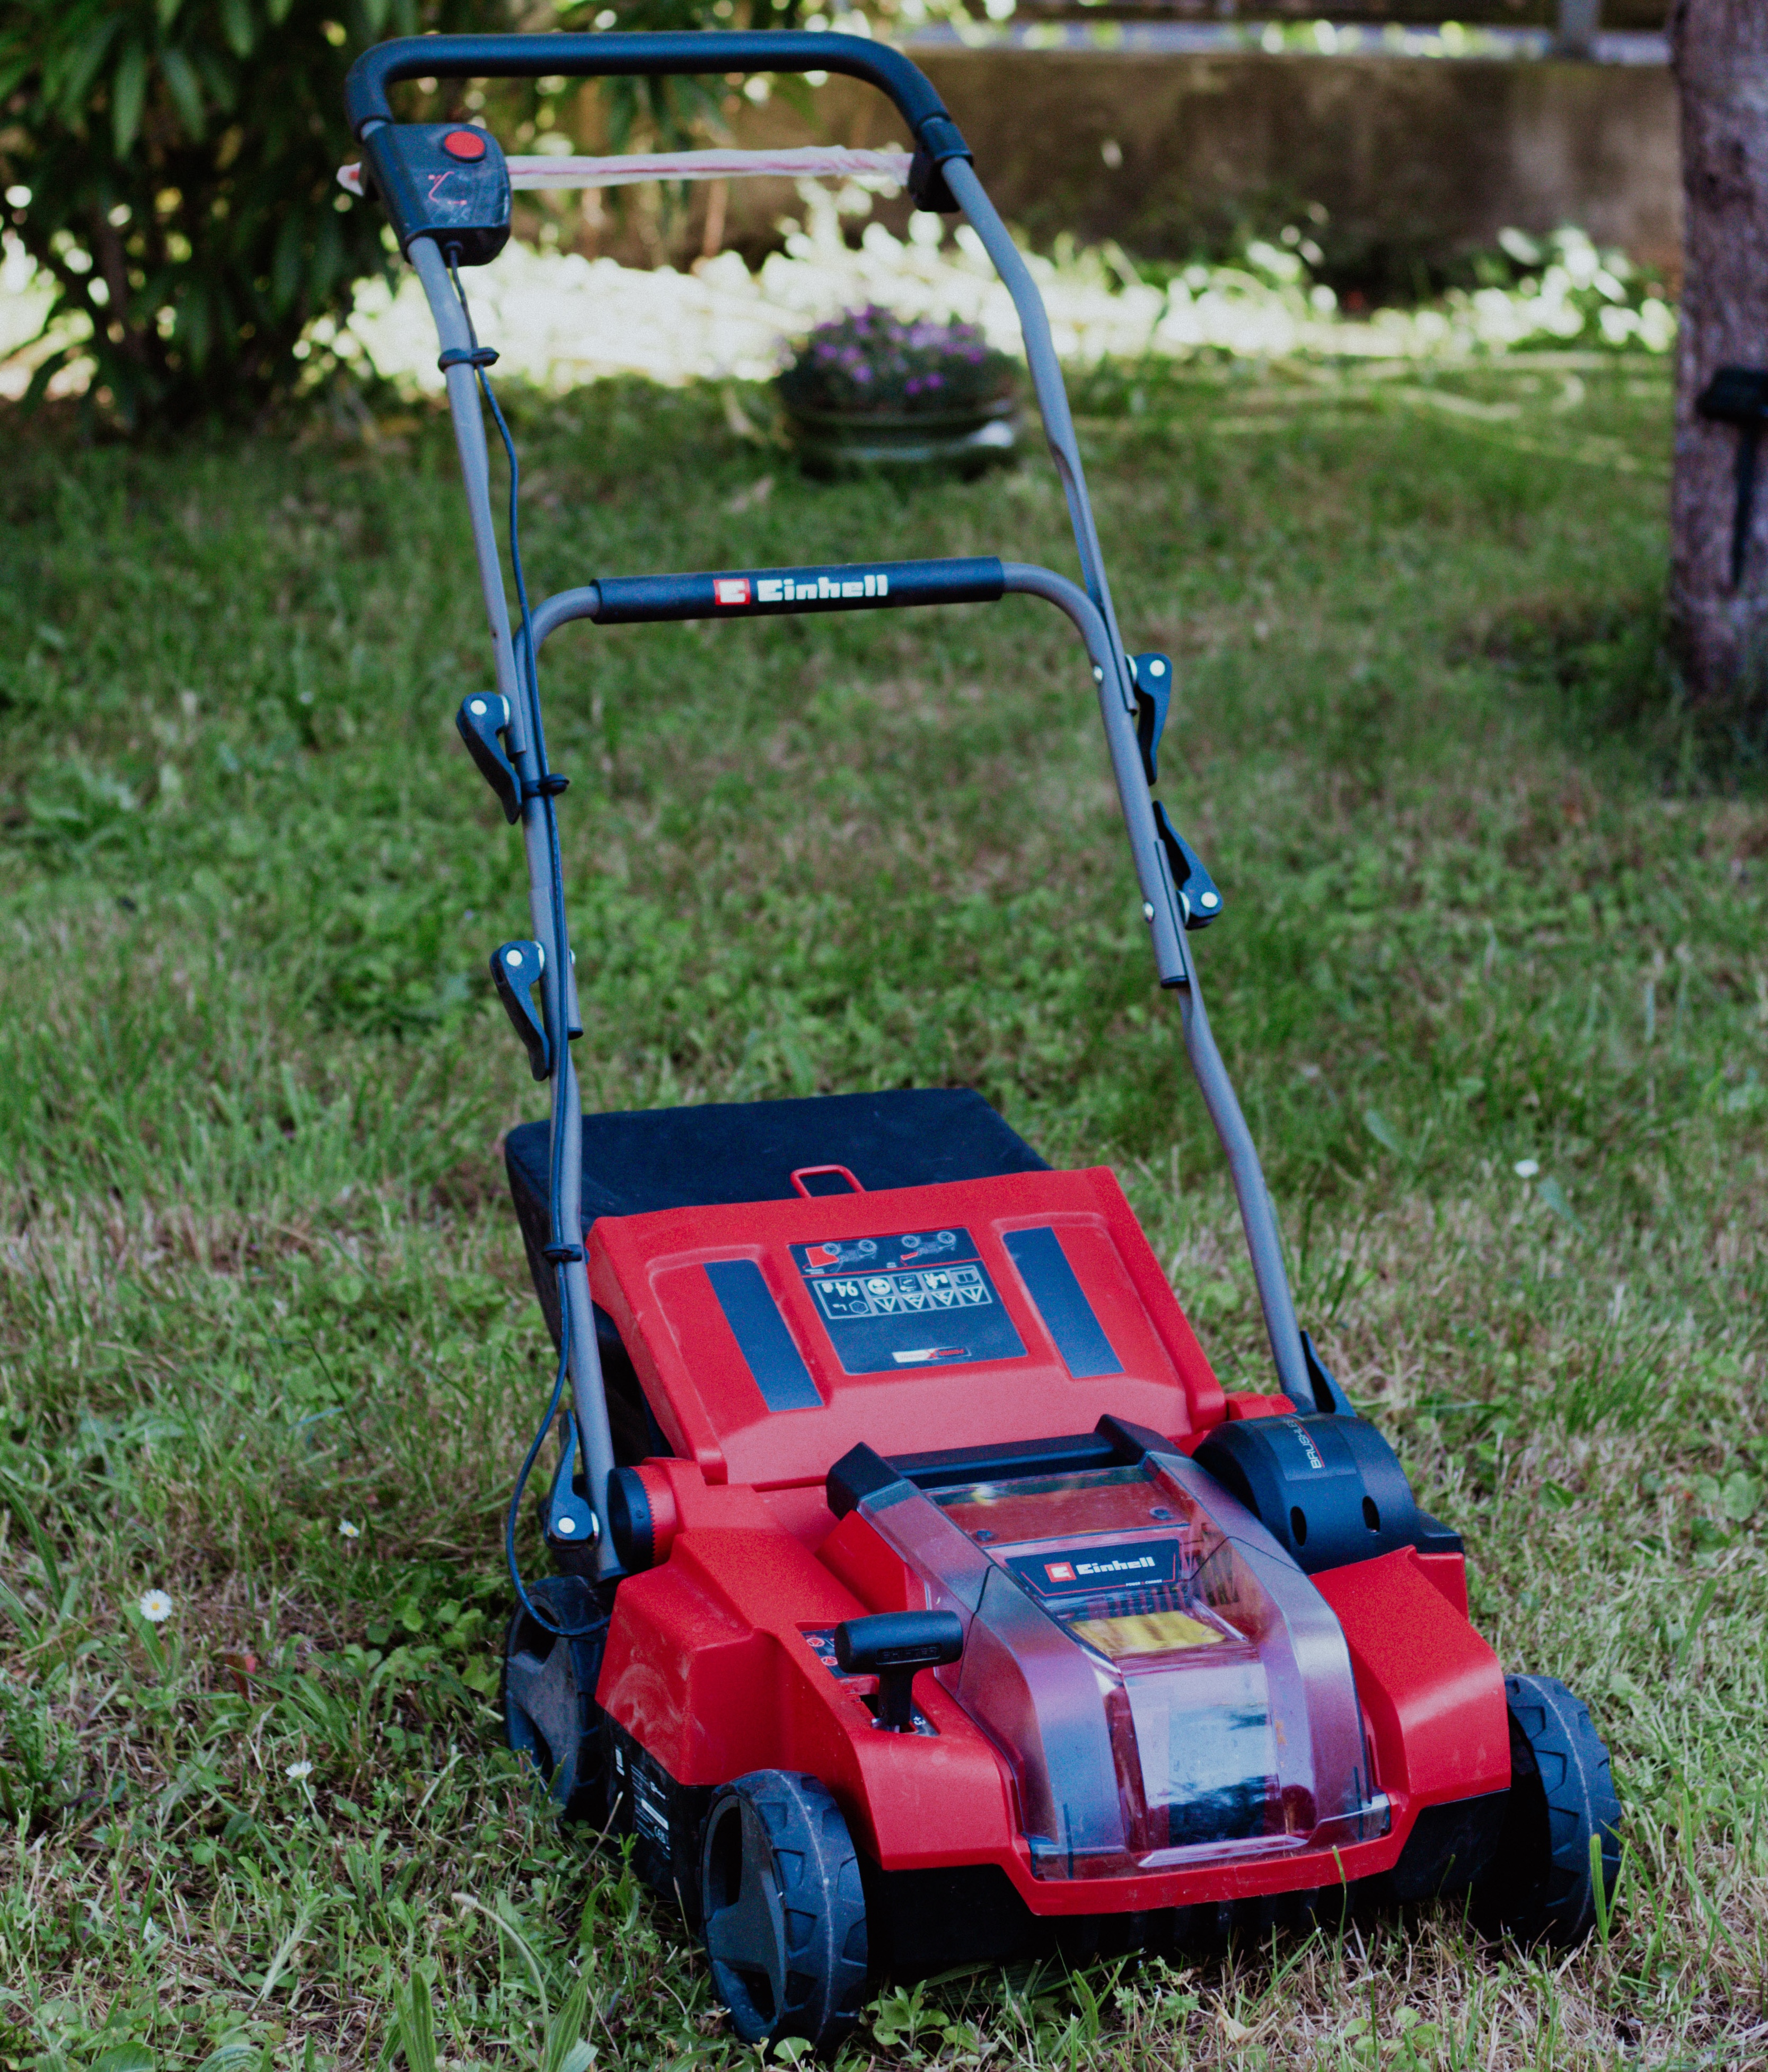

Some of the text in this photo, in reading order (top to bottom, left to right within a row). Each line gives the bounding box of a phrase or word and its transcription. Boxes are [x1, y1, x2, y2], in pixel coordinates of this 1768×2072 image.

[757, 574, 888, 601] Einhell
[835, 1281, 858, 1297] 94
[1284, 1419, 1322, 1468] BRUSHLE
[1076, 1556, 1155, 1575] Einhell
